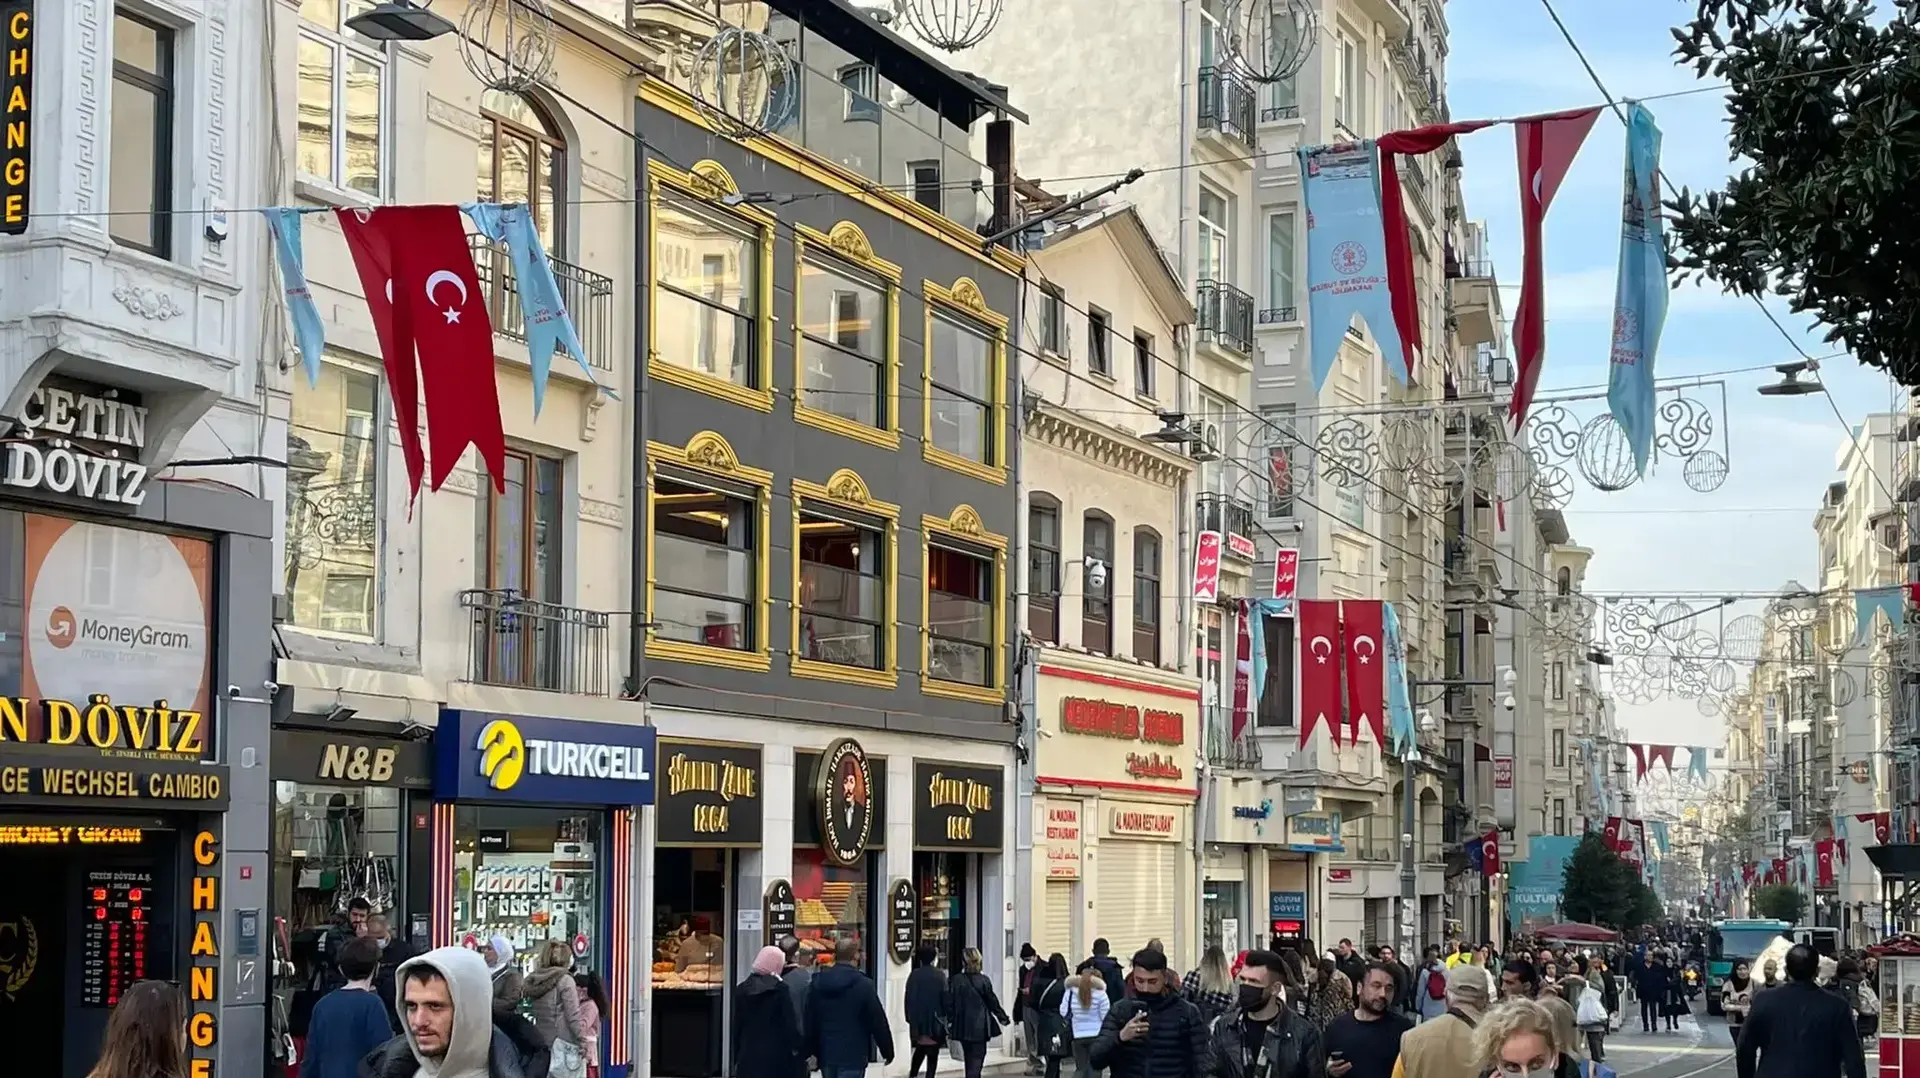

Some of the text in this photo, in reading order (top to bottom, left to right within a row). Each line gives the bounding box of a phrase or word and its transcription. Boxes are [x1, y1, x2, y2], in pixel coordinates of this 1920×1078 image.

[5, 11, 30, 223] CHANGE
[18, 387, 148, 448] ÇETİN
[6, 439, 147, 506] DÖVİZ
[81, 618, 190, 649] MoneyGram
[47, 694, 202, 753] DÖVİZ
[319, 744, 396, 781] N&B
[525, 739, 650, 780] TURKCELL
[1494, 771, 1511, 781] HOP
[43, 768, 139, 796] WECHSEL
[149, 773, 220, 800] CAMBIO
[694, 804, 729, 833] 1864
[189, 831, 217, 1078] CHANGE
